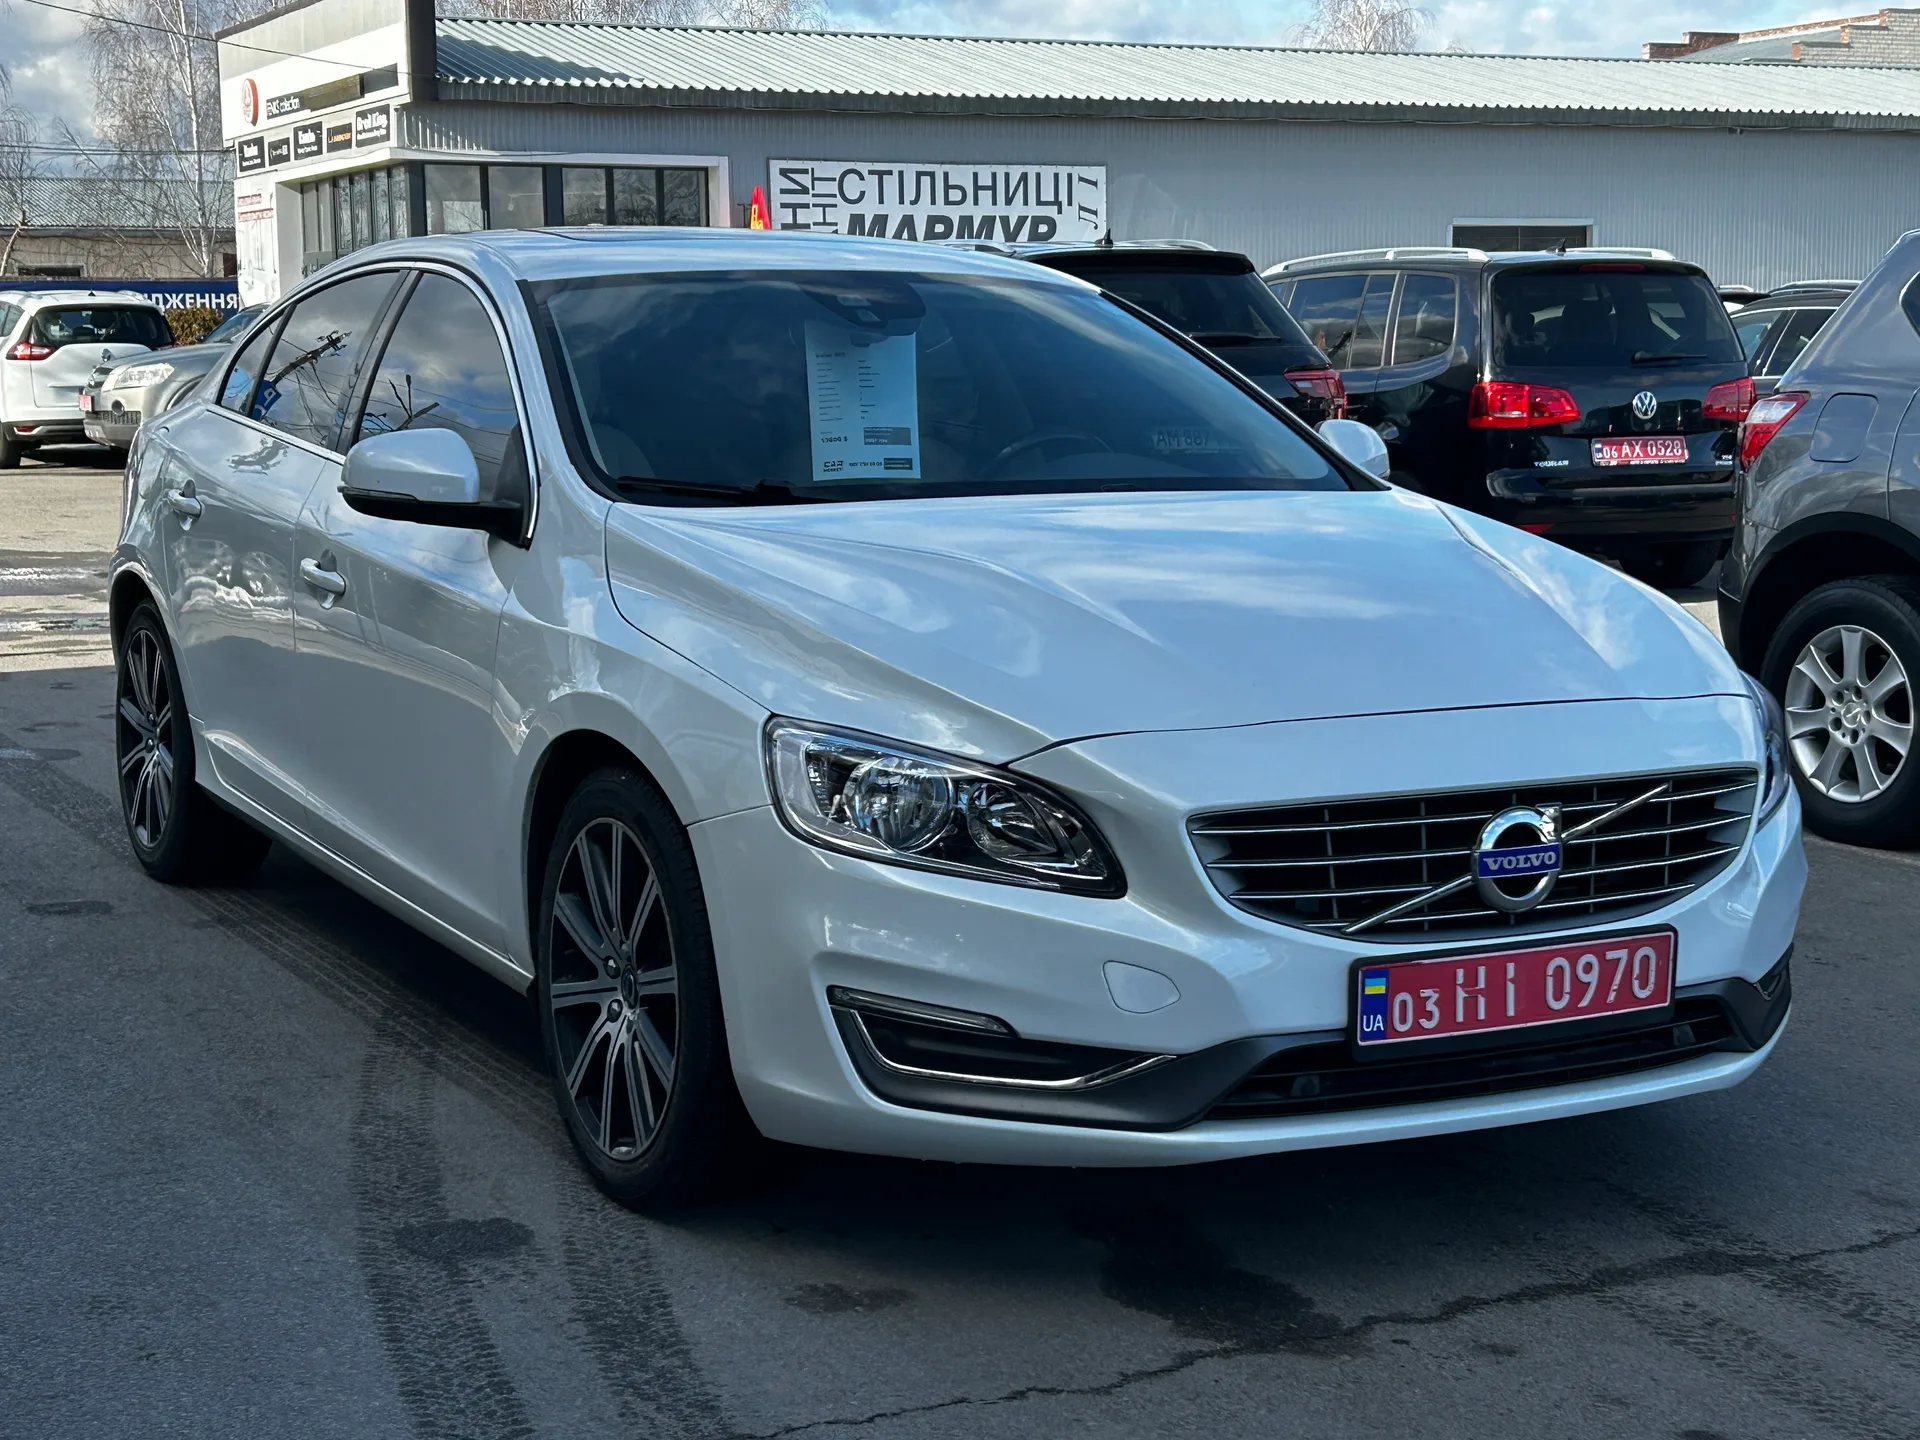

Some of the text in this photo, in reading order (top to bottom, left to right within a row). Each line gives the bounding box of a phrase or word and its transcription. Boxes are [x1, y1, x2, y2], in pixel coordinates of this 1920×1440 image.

[837, 167, 1073, 215] СТІЛЬНИЦІ
[1603, 446, 1619, 458] 06
[1621, 441, 1644, 457] AX
[1647, 440, 1681, 456] 0528
[1483, 852, 1557, 871] VOLVO
[1392, 946, 1657, 1032] 03 HI 0970
[1362, 1014, 1385, 1032] UA
